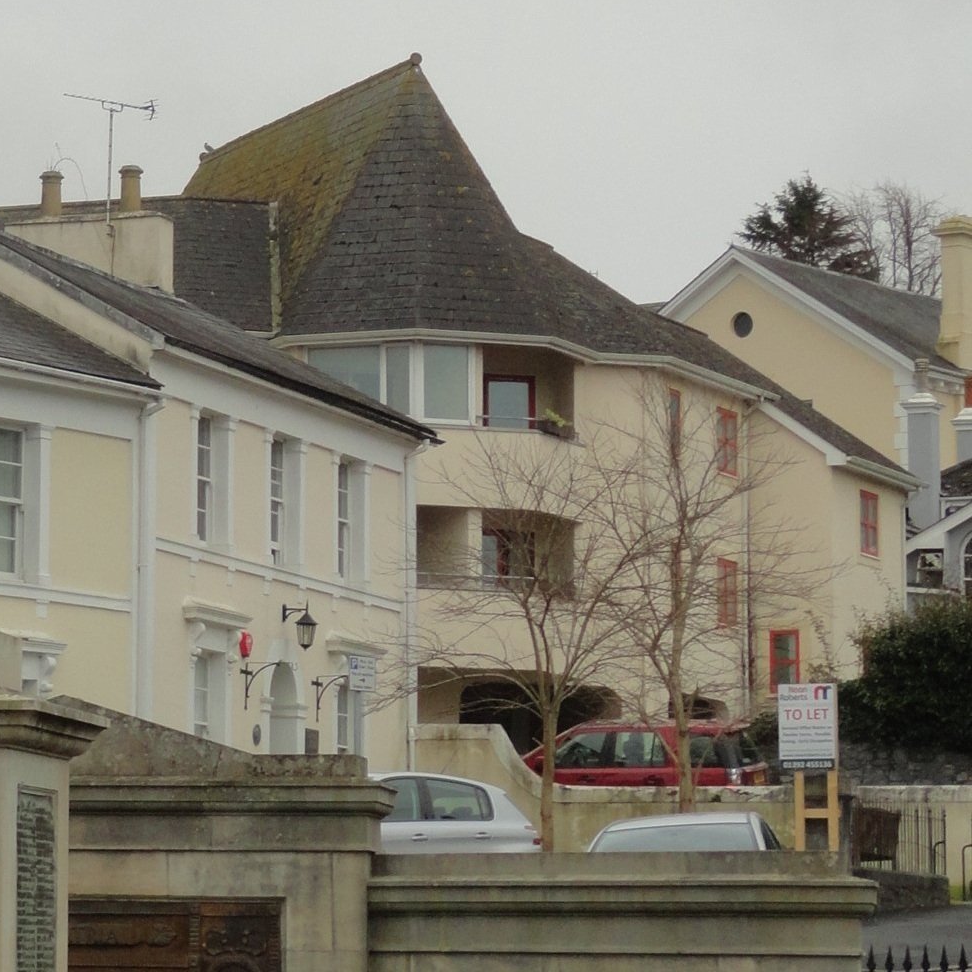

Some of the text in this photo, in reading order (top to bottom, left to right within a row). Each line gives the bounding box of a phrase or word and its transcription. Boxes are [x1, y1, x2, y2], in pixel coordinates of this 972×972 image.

[779, 693, 808, 701] Roberts
[784, 708, 829, 721] TO LET
